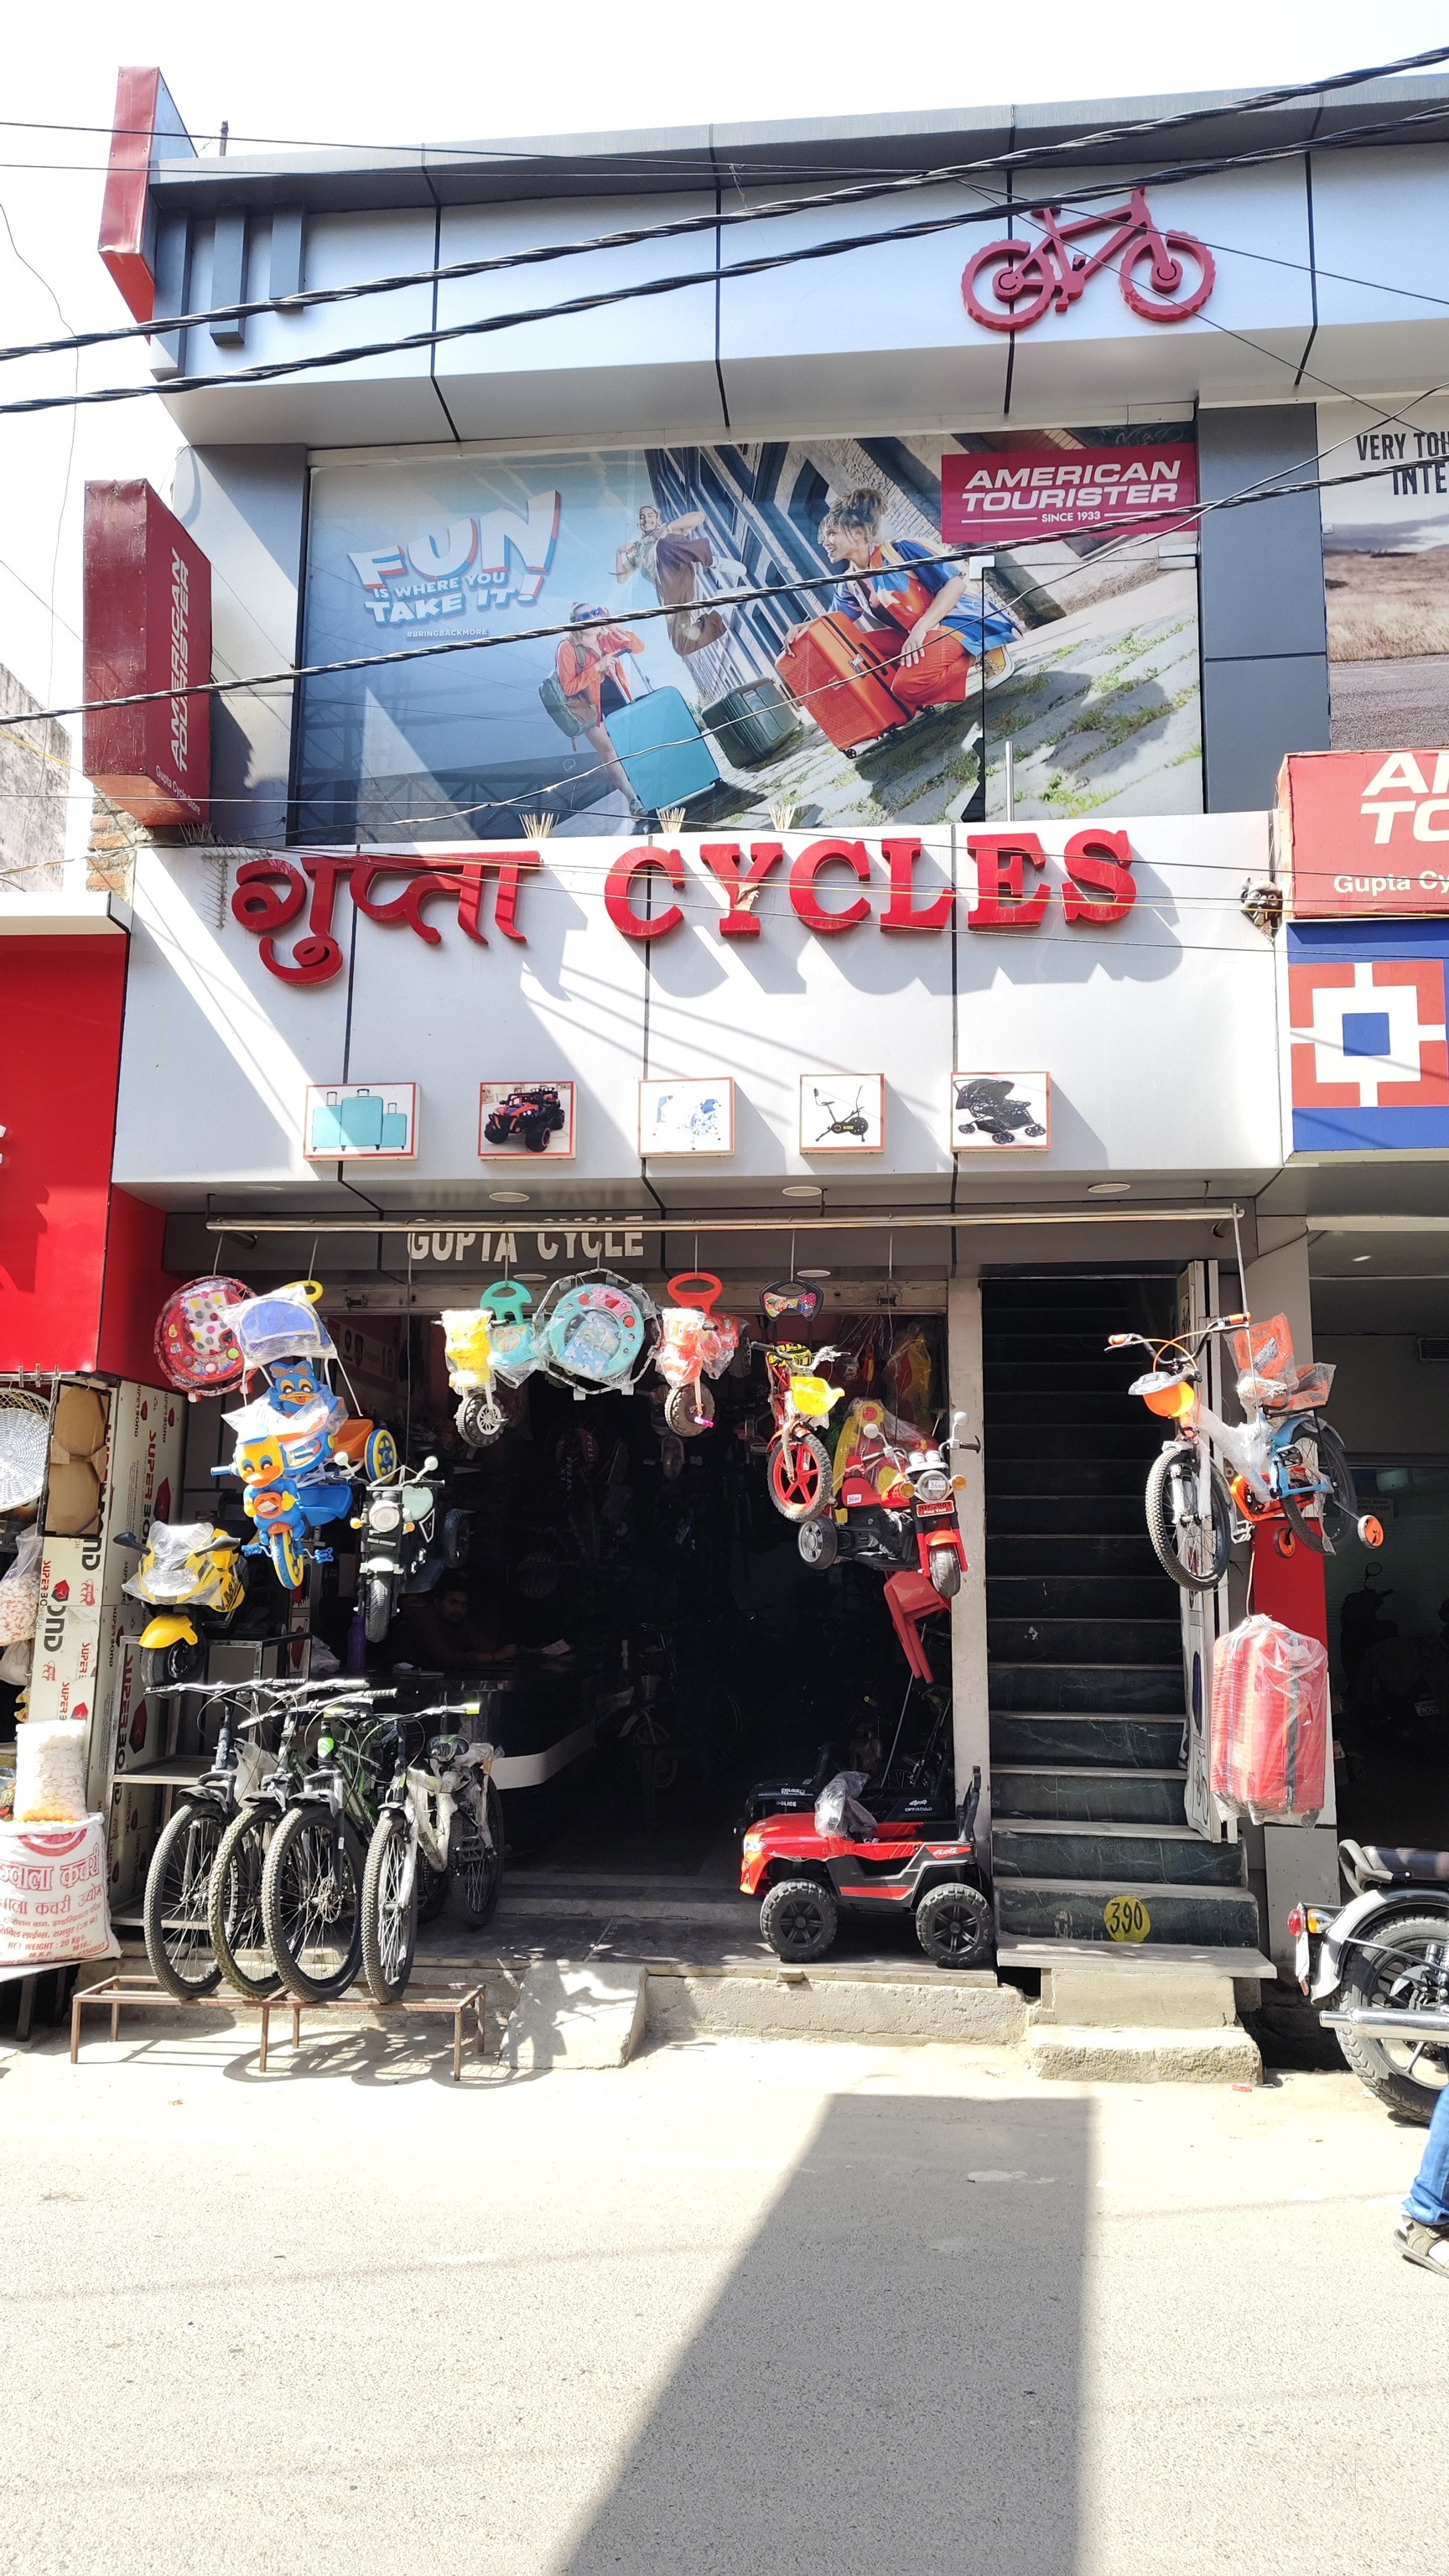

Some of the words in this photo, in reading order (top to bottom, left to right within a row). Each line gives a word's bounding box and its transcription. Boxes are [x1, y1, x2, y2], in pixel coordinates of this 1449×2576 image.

[1355, 433, 1406, 460] VERY
[964, 460, 1182, 490] AMERICAN
[962, 483, 1178, 512] TOURISTER
[1041, 512, 1073, 522] SINCE
[1077, 511, 1101, 521] 1933
[348, 490, 561, 589] FUN
[373, 587, 389, 599] IS
[394, 577, 460, 599] WHERE
[465, 571, 506, 586] YOU
[365, 593, 465, 625] TAKE
[407, 628, 487, 638] #BRINGBACKMORE
[171, 547, 181, 766] AMERICAN
[178, 558, 190, 772] TOURISTER
[155, 764, 173, 790] Gupta
[173, 779, 187, 802] Cycle
[186, 792, 201, 815] Store
[1333, 873, 1411, 896] Gupta
[231, 850, 543, 987] गुप्ता
[604, 828, 1138, 942] CYCLES
[407, 1218, 517, 1263] GUPTA
[538, 1215, 644, 1260] CYCLE
[1109, 1901, 1143, 1935] 390
[25, 1941, 55, 1950] WEIGHT
[60, 1938, 70, 1947] 20
